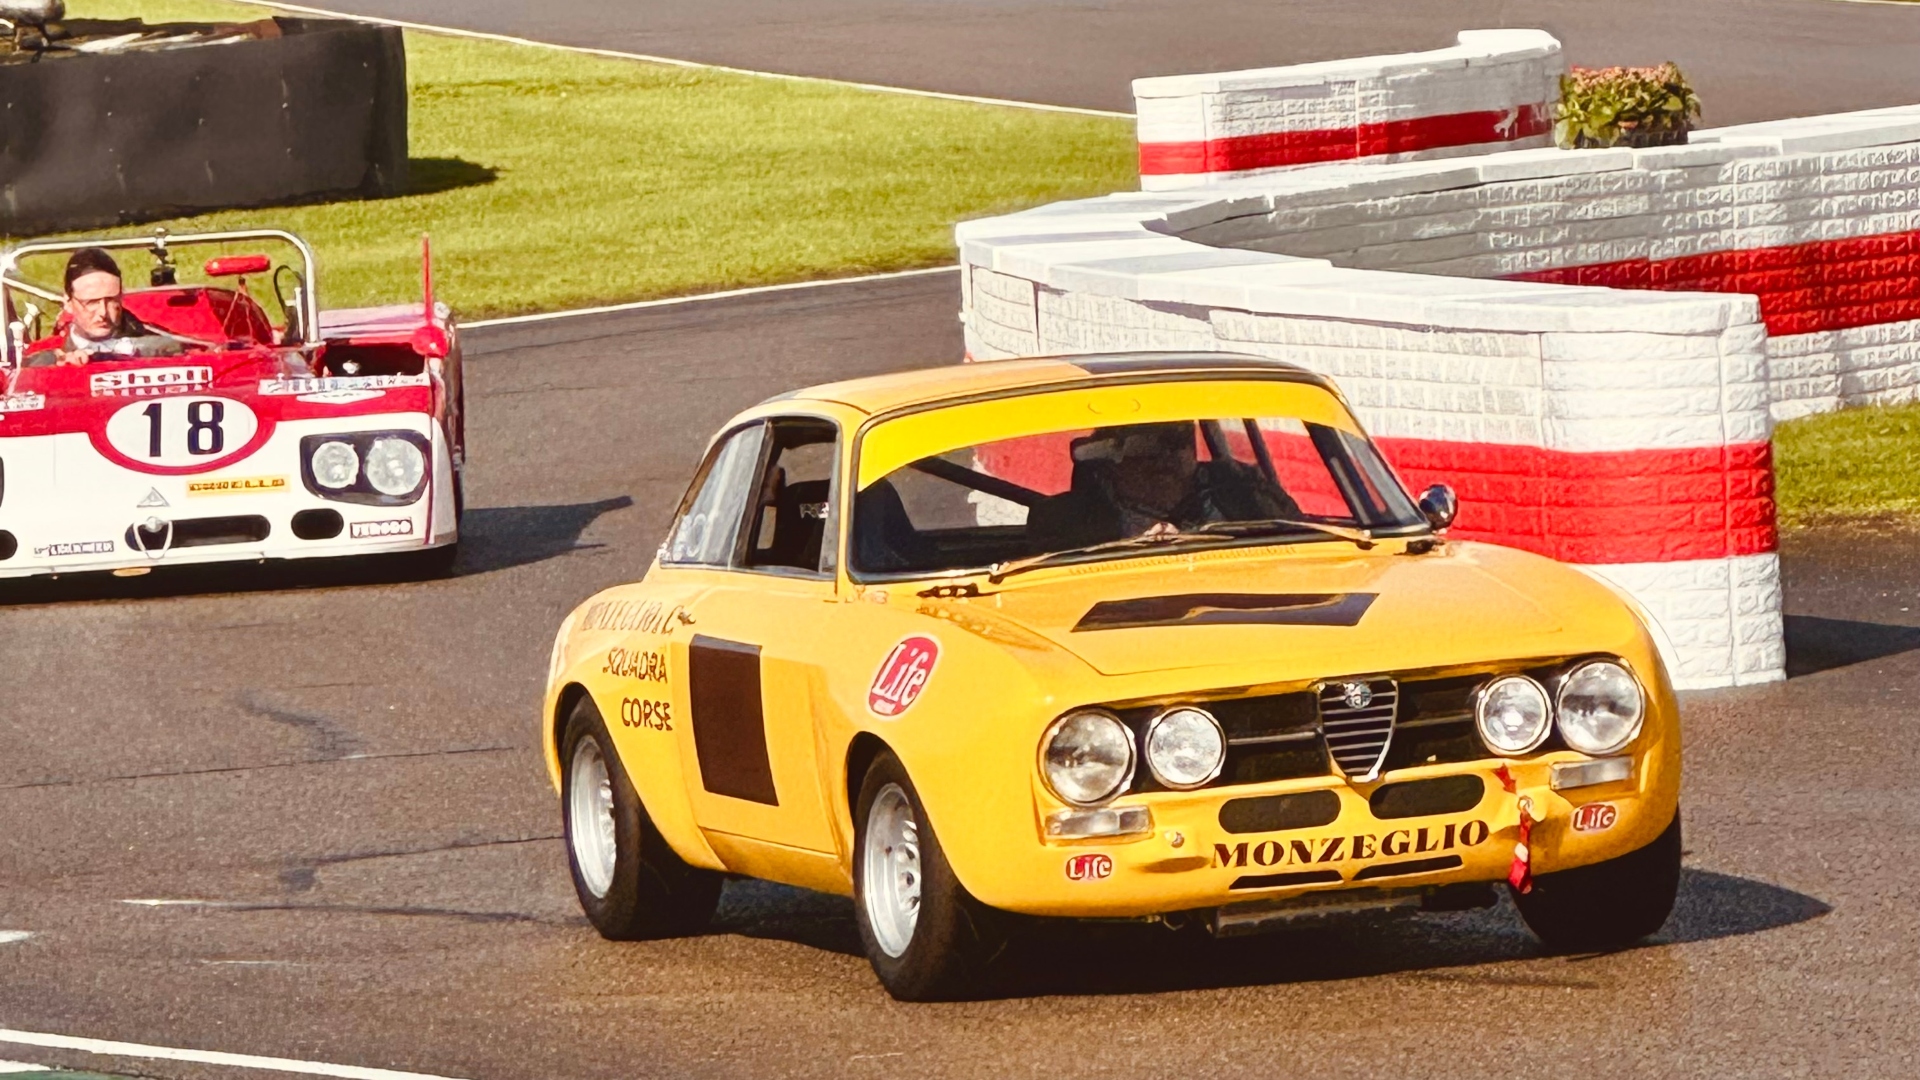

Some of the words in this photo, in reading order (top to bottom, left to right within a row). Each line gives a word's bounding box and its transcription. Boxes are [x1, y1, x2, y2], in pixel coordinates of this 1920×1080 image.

[142, 400, 224, 457] 18
[602, 647, 668, 684] SQUADRA
[871, 642, 929, 707] Life
[621, 697, 673, 731] CORSE
[1210, 820, 1490, 869] MONZEGLIO
